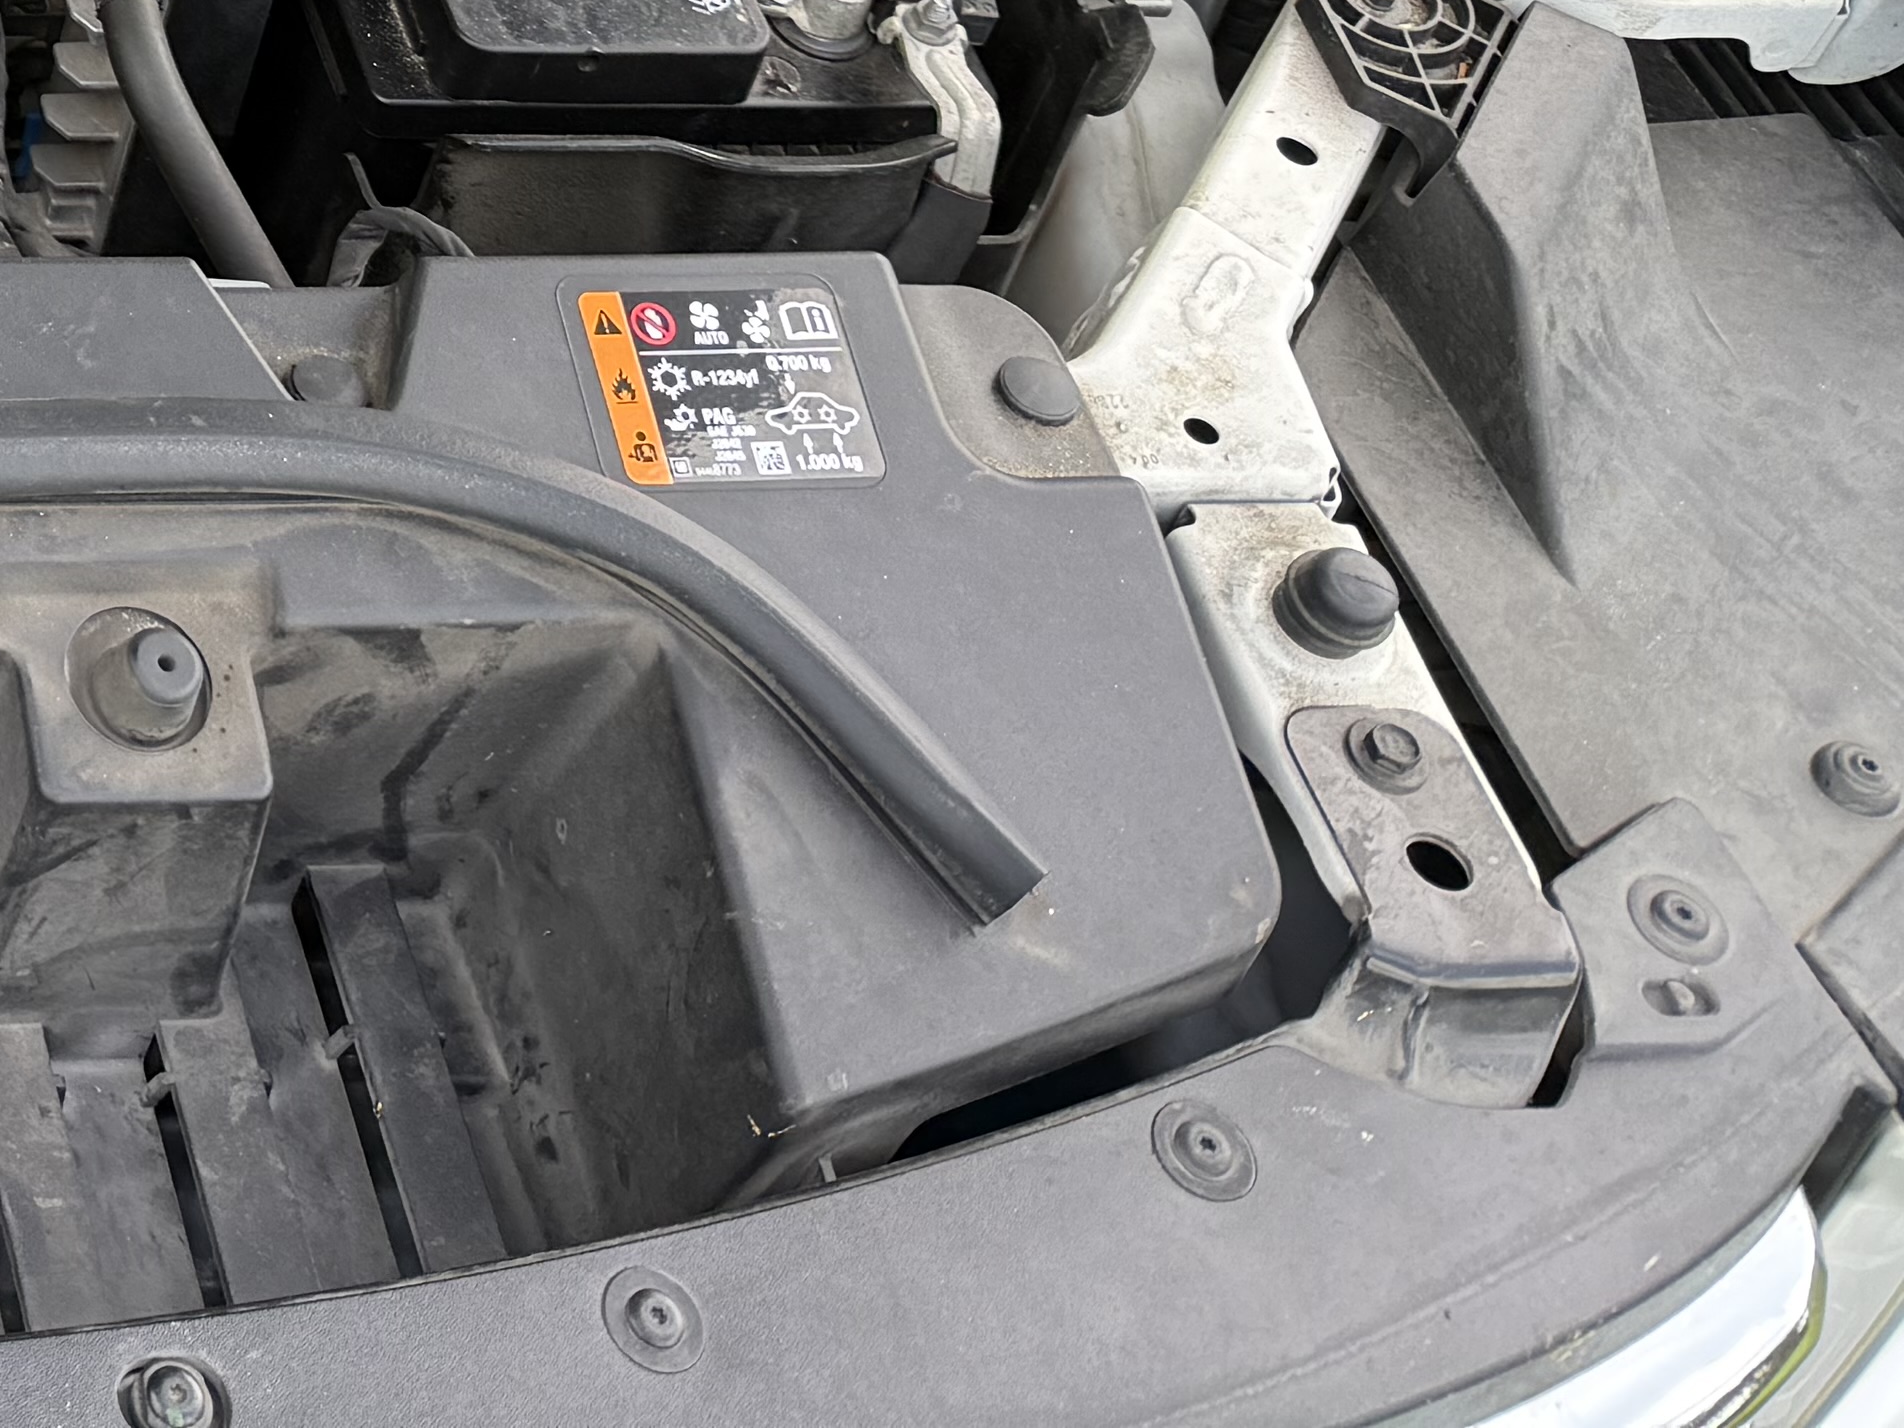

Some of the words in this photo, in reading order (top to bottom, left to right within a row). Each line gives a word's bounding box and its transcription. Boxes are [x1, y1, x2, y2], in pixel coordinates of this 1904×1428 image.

[694, 331, 729, 345] AUTO
[765, 355, 808, 372] 0.700
[810, 355, 832, 373] kg
[701, 407, 737, 425] PAG
[795, 454, 839, 472] 1.000
[842, 454, 864, 473] kg
